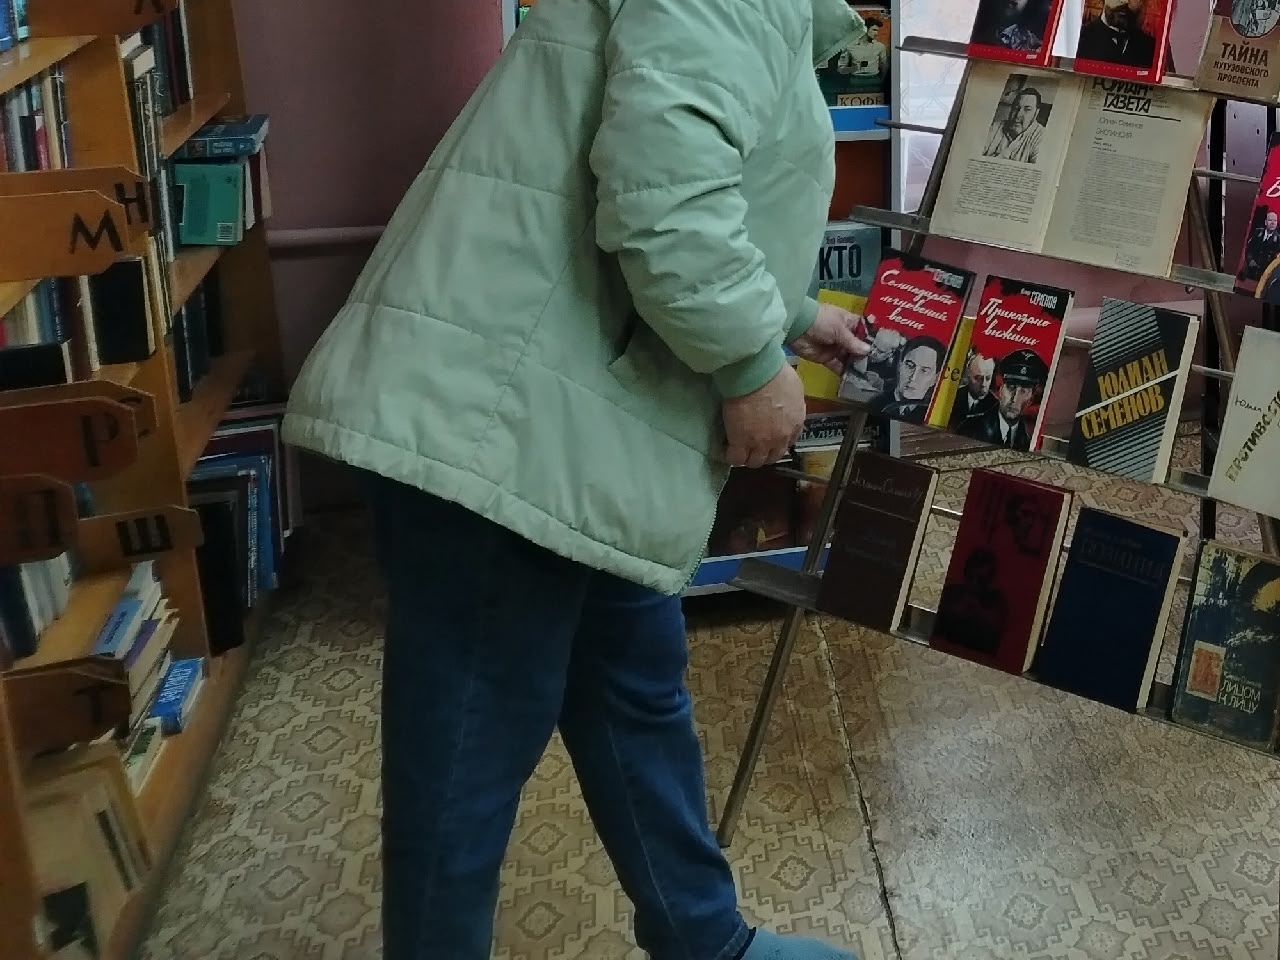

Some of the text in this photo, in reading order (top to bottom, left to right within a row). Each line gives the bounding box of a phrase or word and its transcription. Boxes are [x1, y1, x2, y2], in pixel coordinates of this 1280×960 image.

[1220, 41, 1269, 67] ТАЙНА
[1213, 60, 1269, 78] КУТУЗОВСКОГО
[1216, 72, 1259, 88] ПРОСПЕКТА
[1103, 92, 1152, 113] ГАЗЕТА
[70, 212, 122, 255] М
[818, 243, 862, 281] КТО
[880, 269, 957, 306] Семнадцать
[880, 295, 948, 322] мгновений
[887, 306, 925, 331] весны
[981, 297, 1051, 331] Приказано
[1097, 347, 1169, 401] ЮЛИАН
[1080, 384, 1166, 441] СЕМЕНОВ
[1220, 679, 1261, 702] ЛИЦОМ
[1228, 695, 1260, 715] ЛИЦУ
